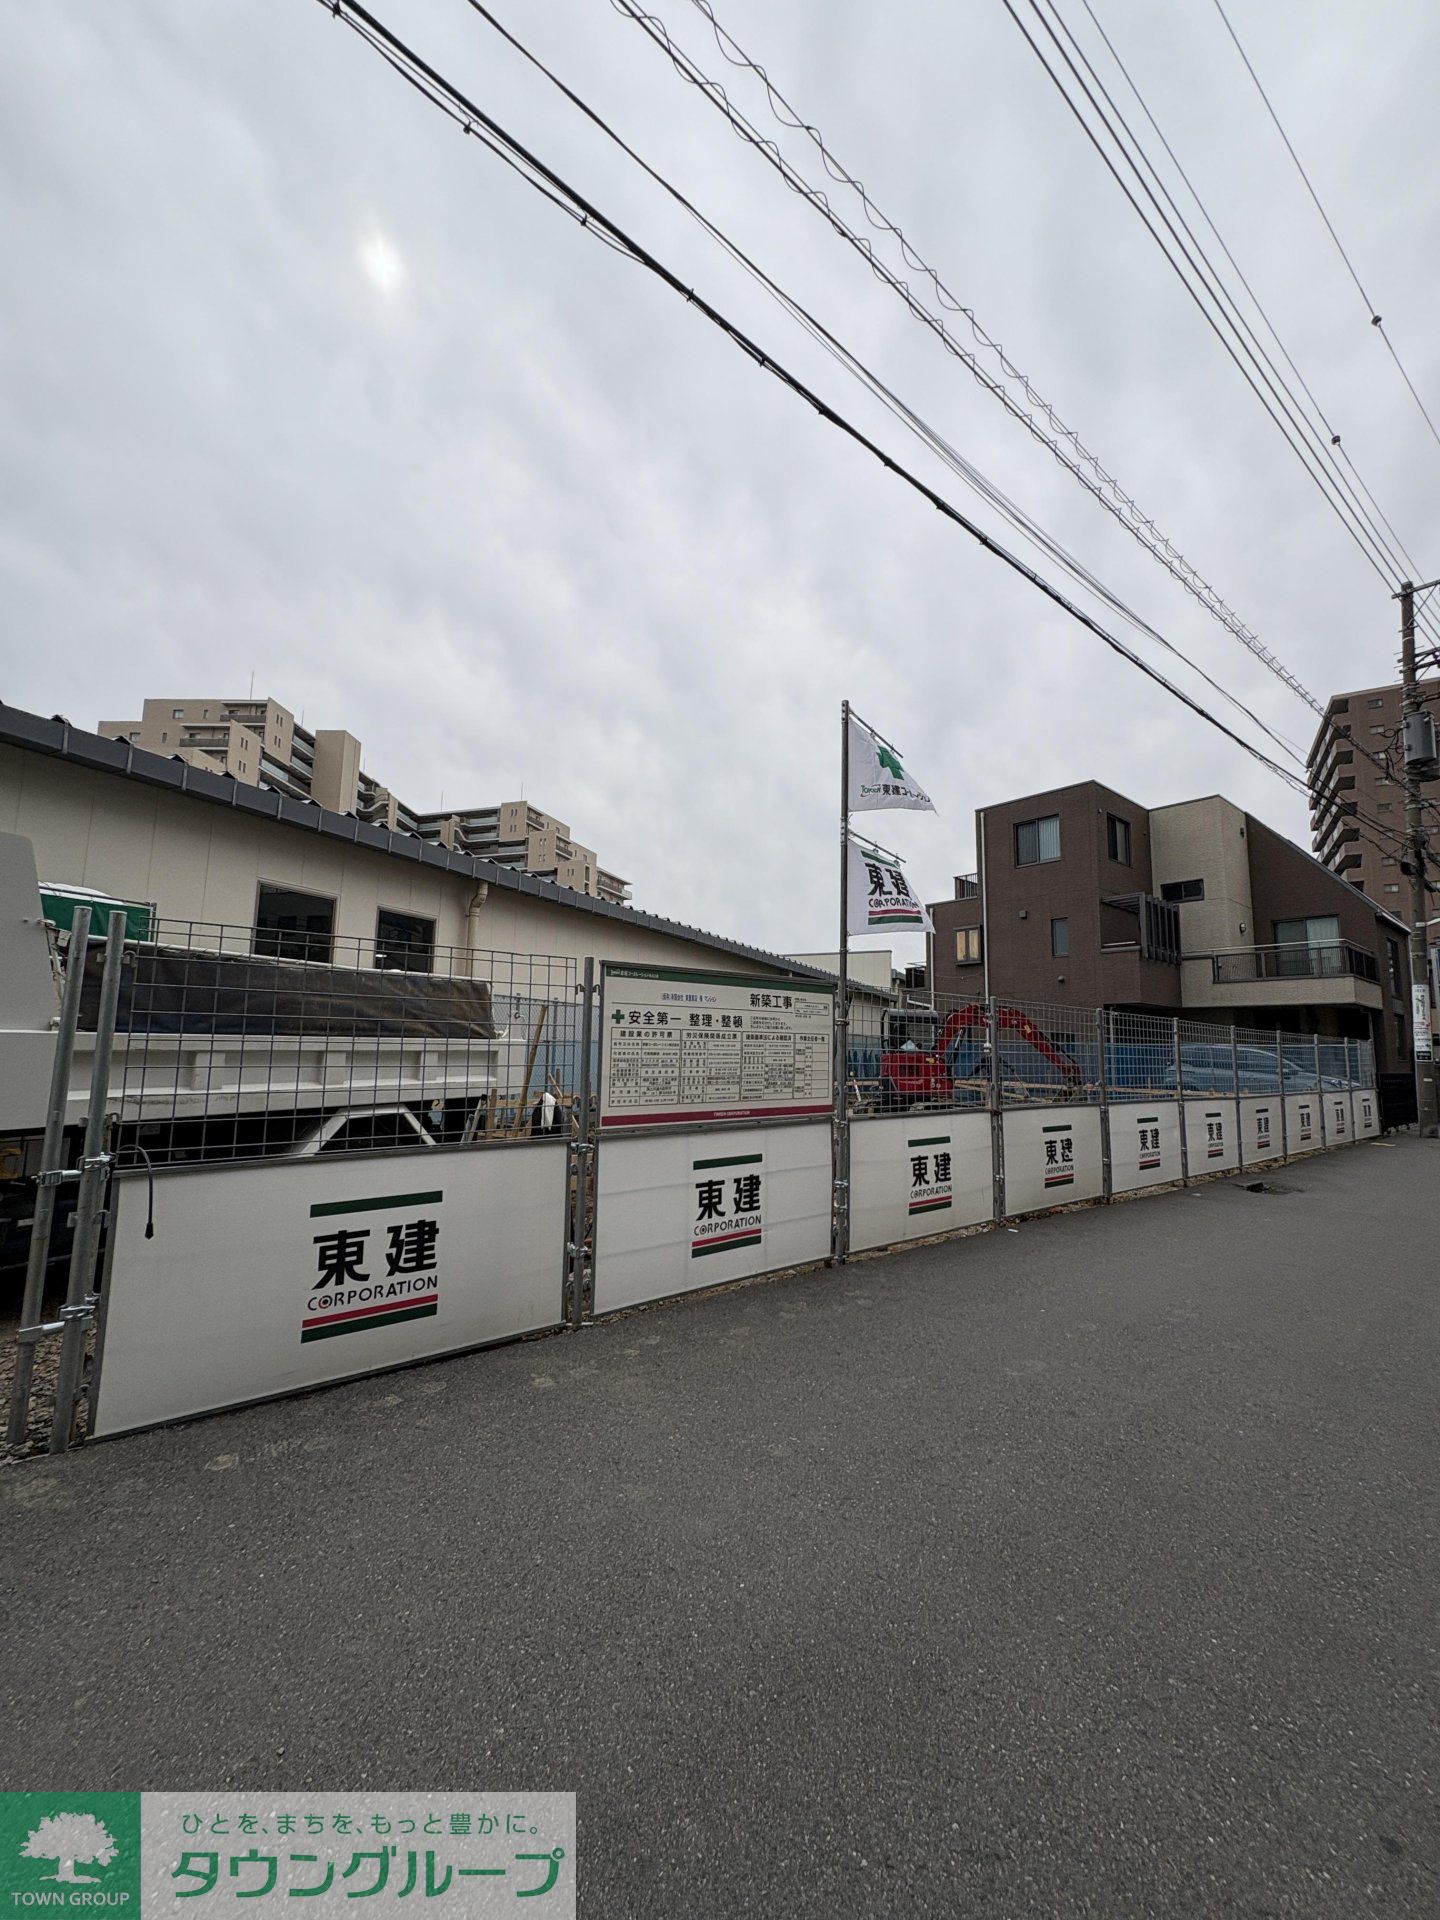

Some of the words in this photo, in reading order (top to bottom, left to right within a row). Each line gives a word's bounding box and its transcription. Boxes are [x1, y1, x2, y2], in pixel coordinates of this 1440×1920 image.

[864, 863, 912, 899] 東建
[749, 993, 793, 1009] 新築工事
[628, 1010, 682, 1025] 安全第一
[689, 1013, 743, 1029] 整理・整頓
[1044, 1138, 1074, 1166] 東建
[1139, 1128, 1160, 1151] 東建
[910, 1151, 952, 1188] 東建
[695, 1173, 762, 1222] 東建
[910, 1184, 953, 1199] CORPORATION
[693, 1214, 762, 1237] CORPORATION
[310, 1219, 440, 1291] 東建
[307, 1275, 438, 1311] CORPORATION
